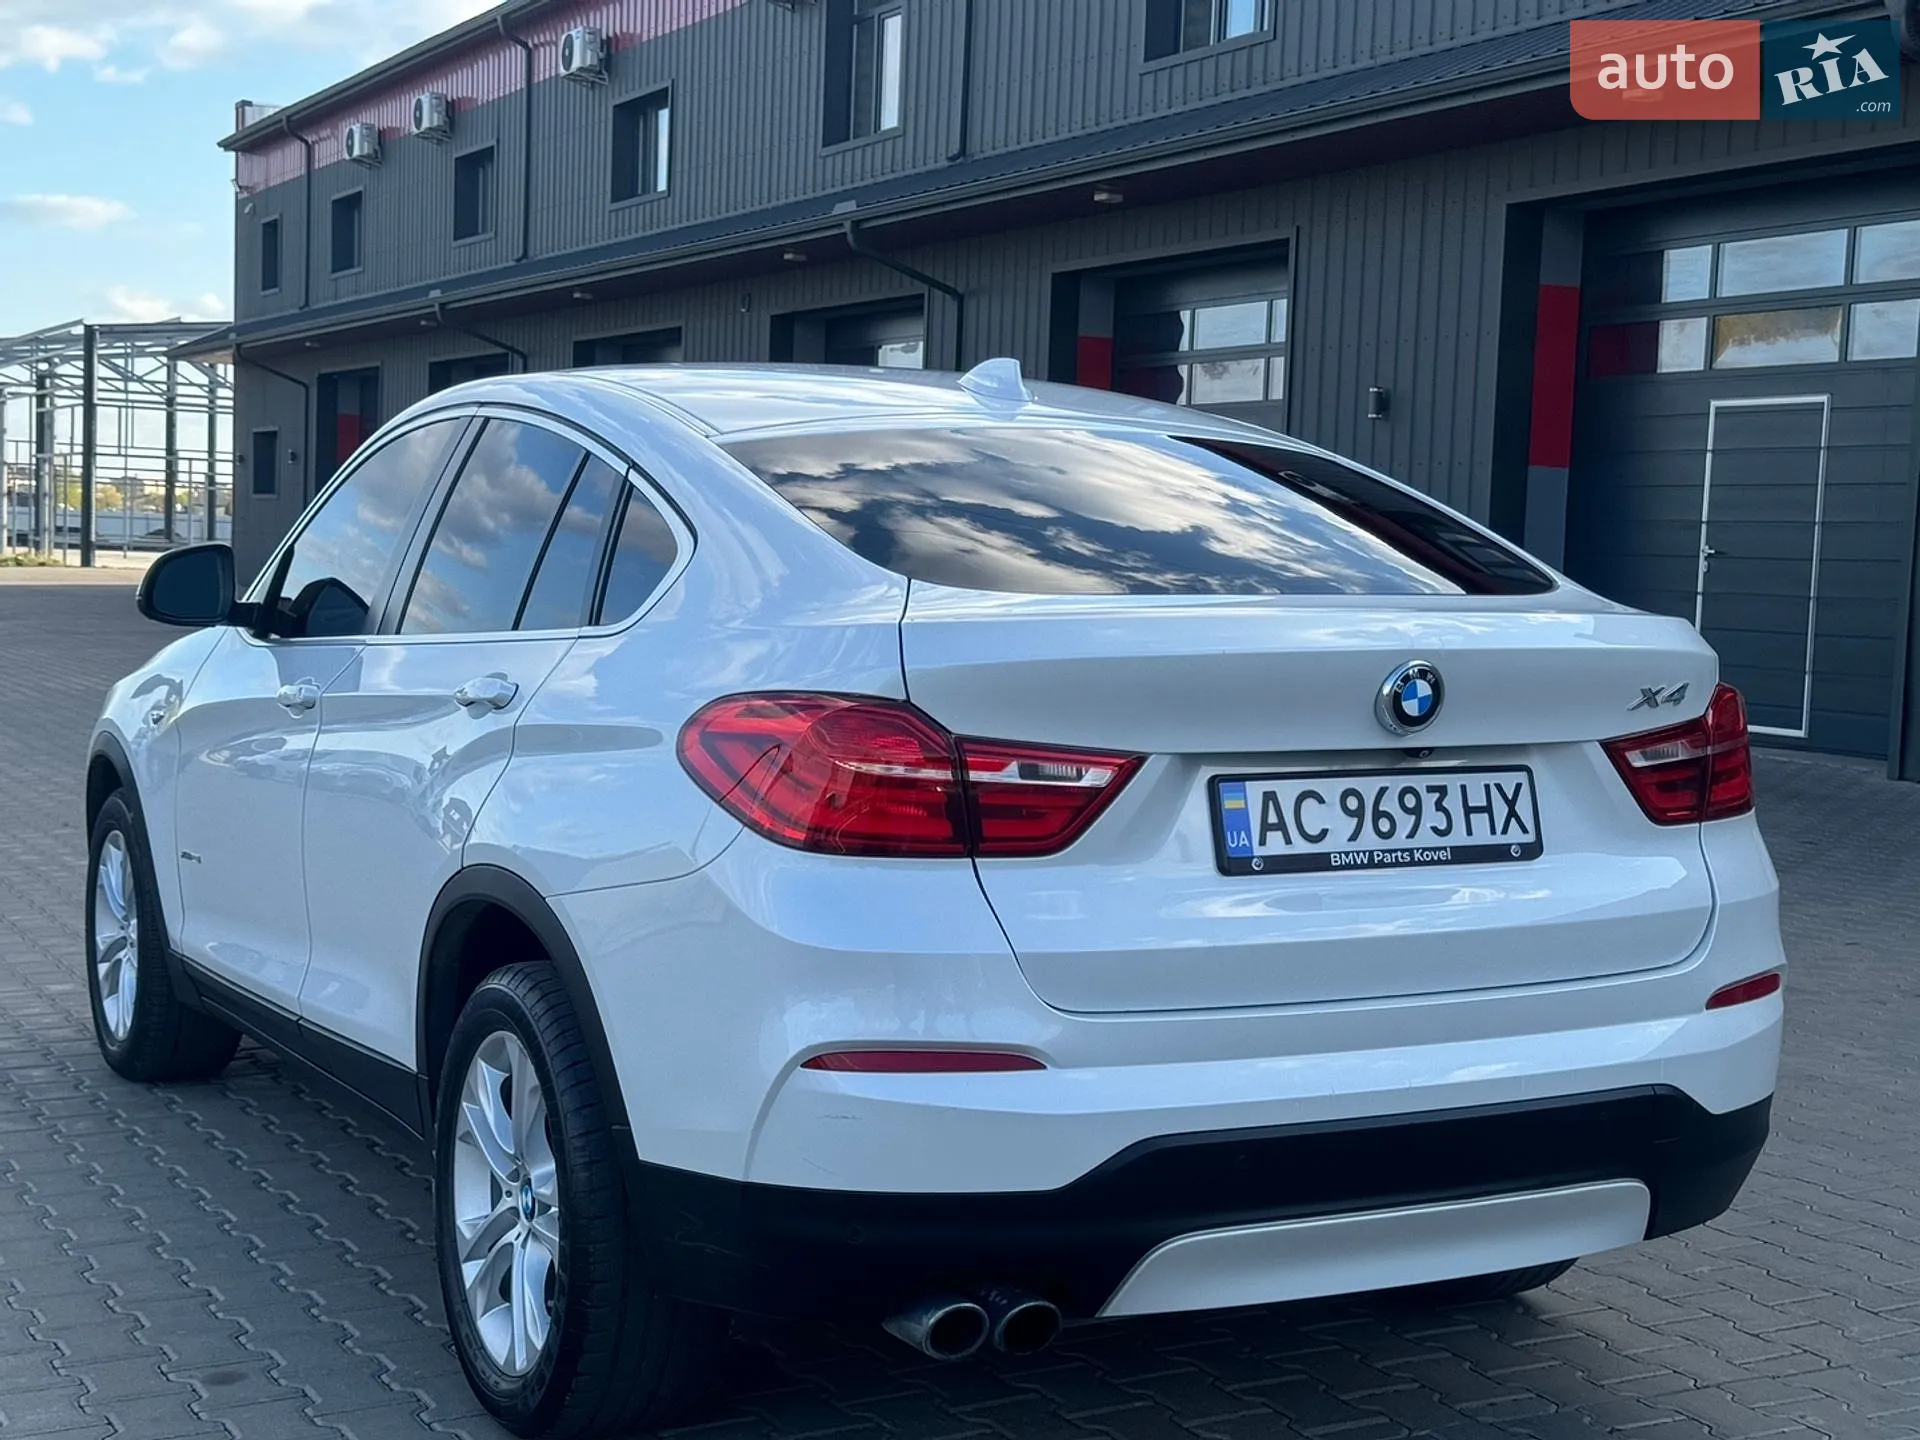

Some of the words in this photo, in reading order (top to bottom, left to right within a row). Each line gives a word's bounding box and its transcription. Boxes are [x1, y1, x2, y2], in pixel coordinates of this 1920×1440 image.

[1626, 682, 1690, 711] X4
[1257, 790, 1330, 847] AC
[1339, 784, 1454, 842] 9693
[1459, 782, 1530, 837] HX
[1226, 830, 1250, 848] UA
[1330, 852, 1371, 867] BMW
[1373, 850, 1411, 864] Parts
[1413, 847, 1452, 863] Kovel
